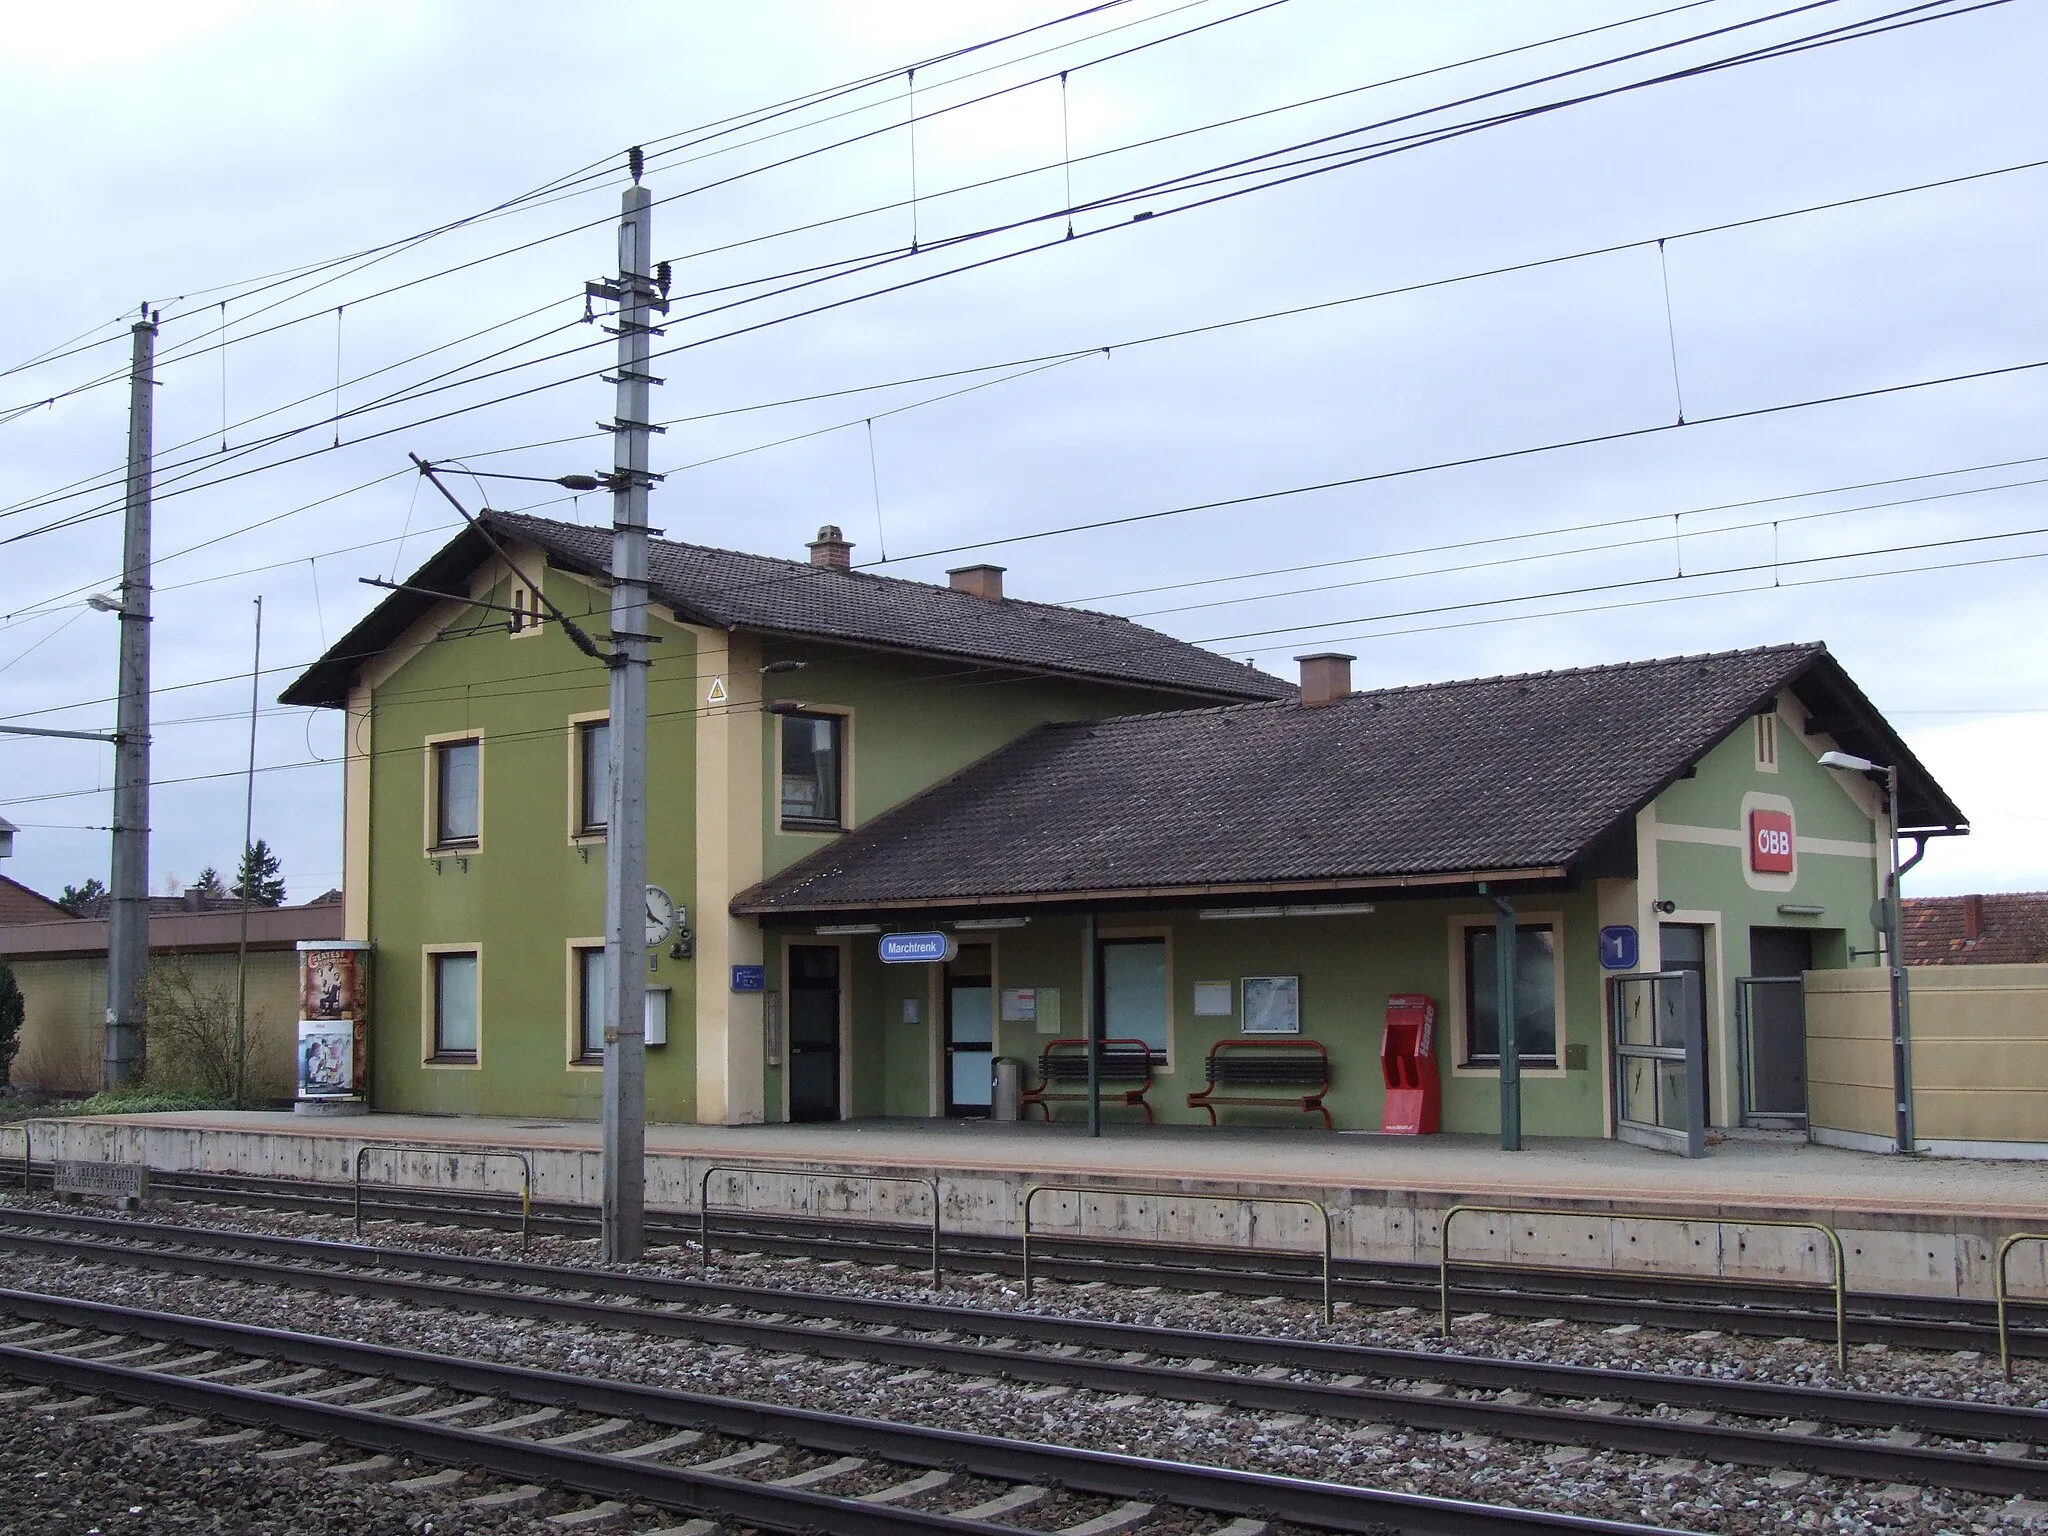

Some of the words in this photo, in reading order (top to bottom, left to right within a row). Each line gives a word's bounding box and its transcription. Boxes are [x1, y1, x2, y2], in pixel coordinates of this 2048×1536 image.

[1758, 829, 1789, 855] ÖBB
[888, 941, 937, 953] Marchtrenk
[1612, 936, 1623, 958] 1
[107, 1179, 139, 1191] VERBOTEN
